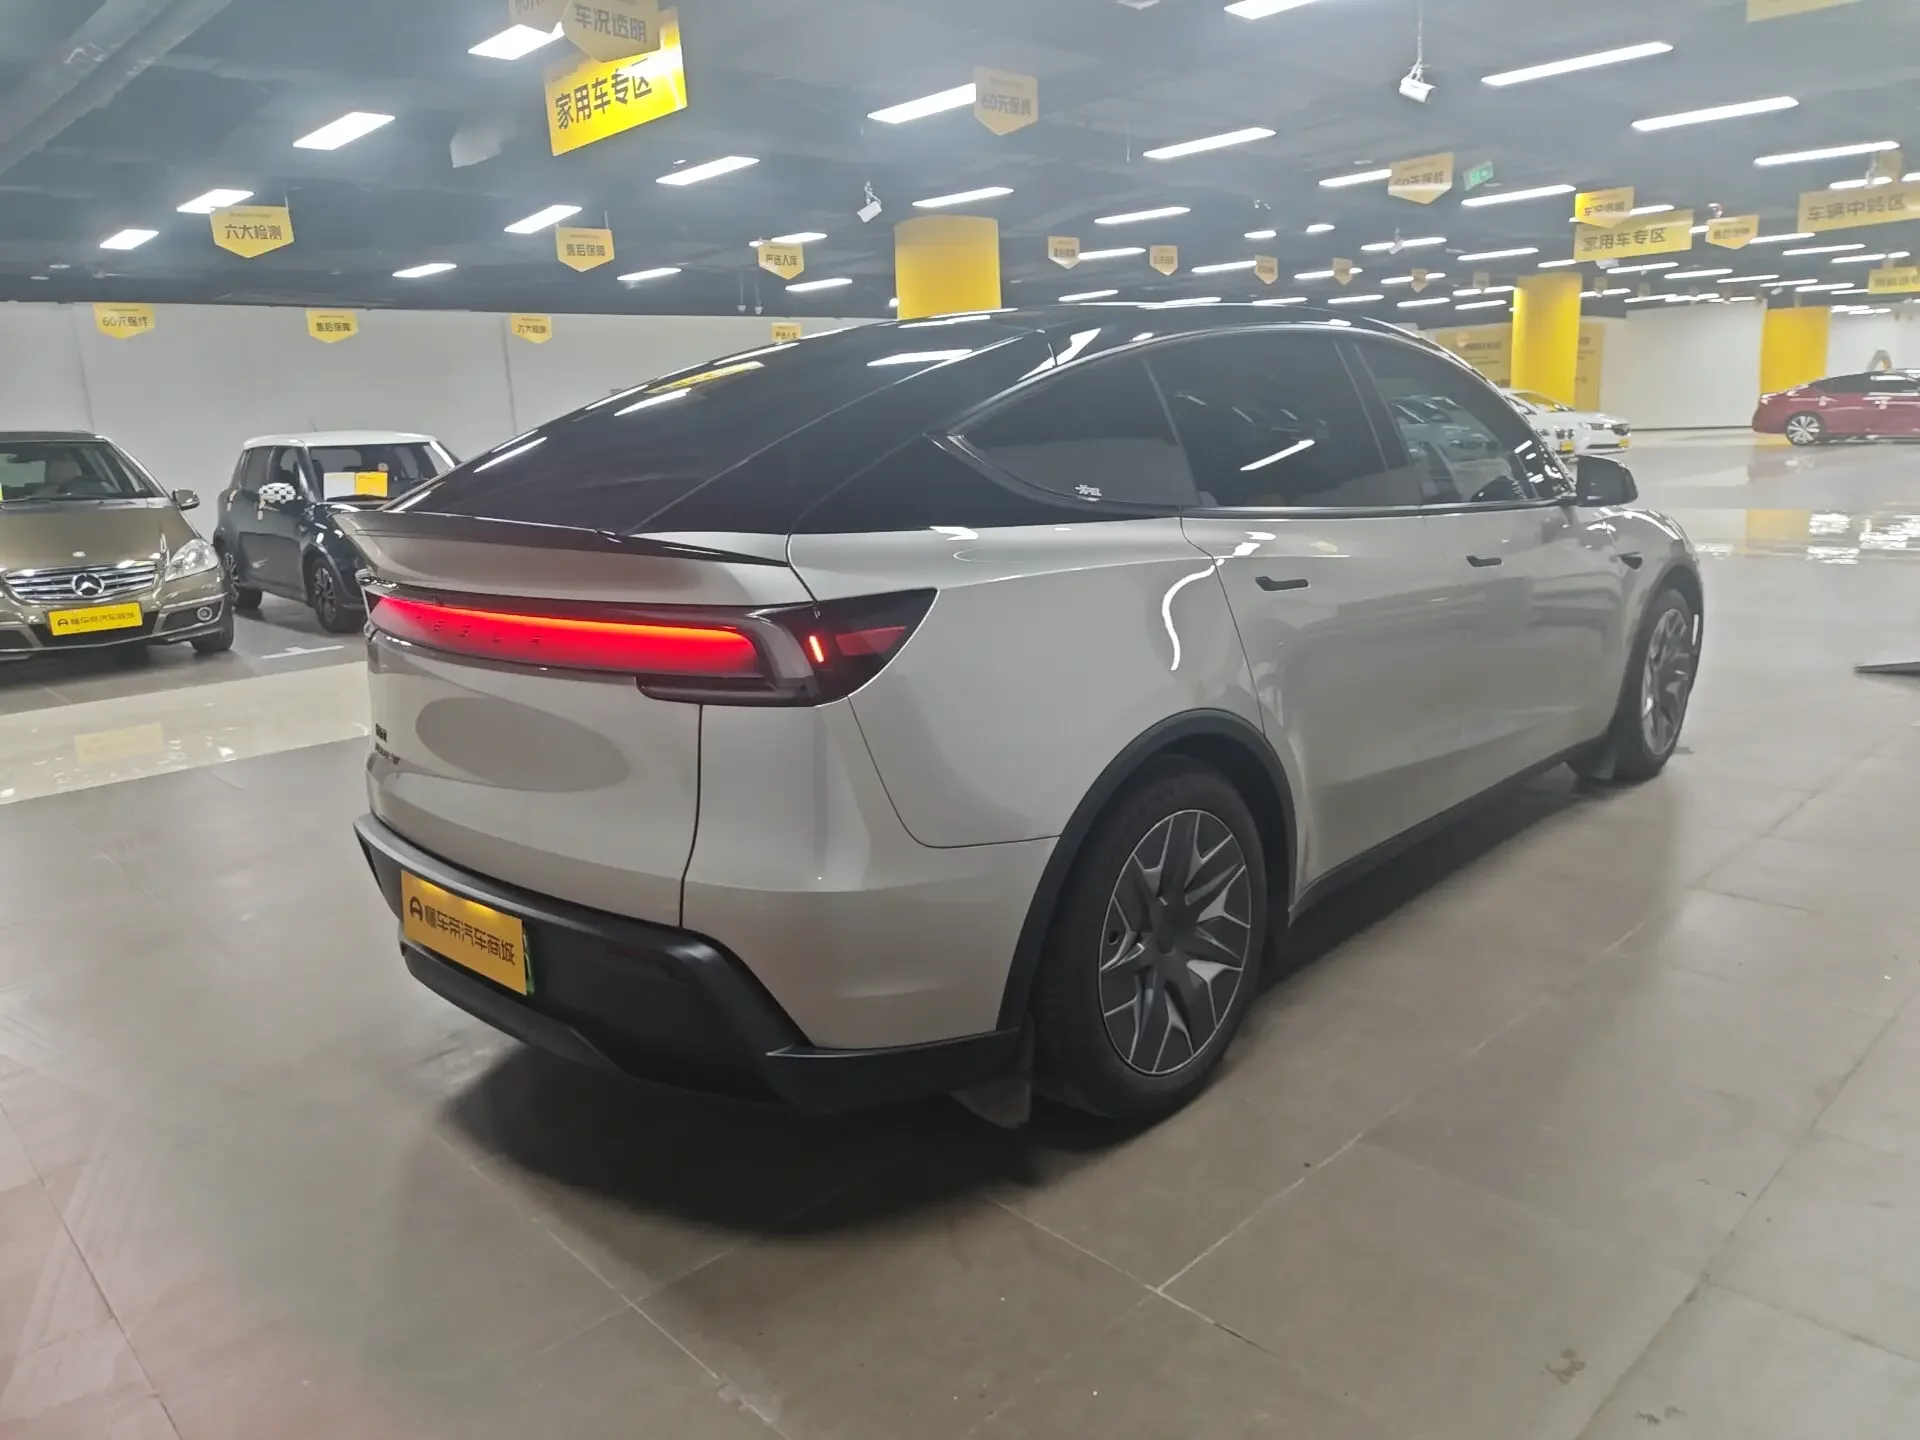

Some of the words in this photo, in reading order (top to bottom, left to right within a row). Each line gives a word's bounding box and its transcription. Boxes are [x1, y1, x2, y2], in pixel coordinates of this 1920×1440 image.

[574, 4, 648, 44] 车况透明
[555, 60, 653, 130] 家用车专区
[224, 224, 283, 241] 六大检测
[1583, 227, 1667, 251] 家用车专区
[566, 244, 606, 257] 售后保障
[766, 254, 797, 266] 严选入库
[424, 904, 516, 966] 懂车帝汽车商城
